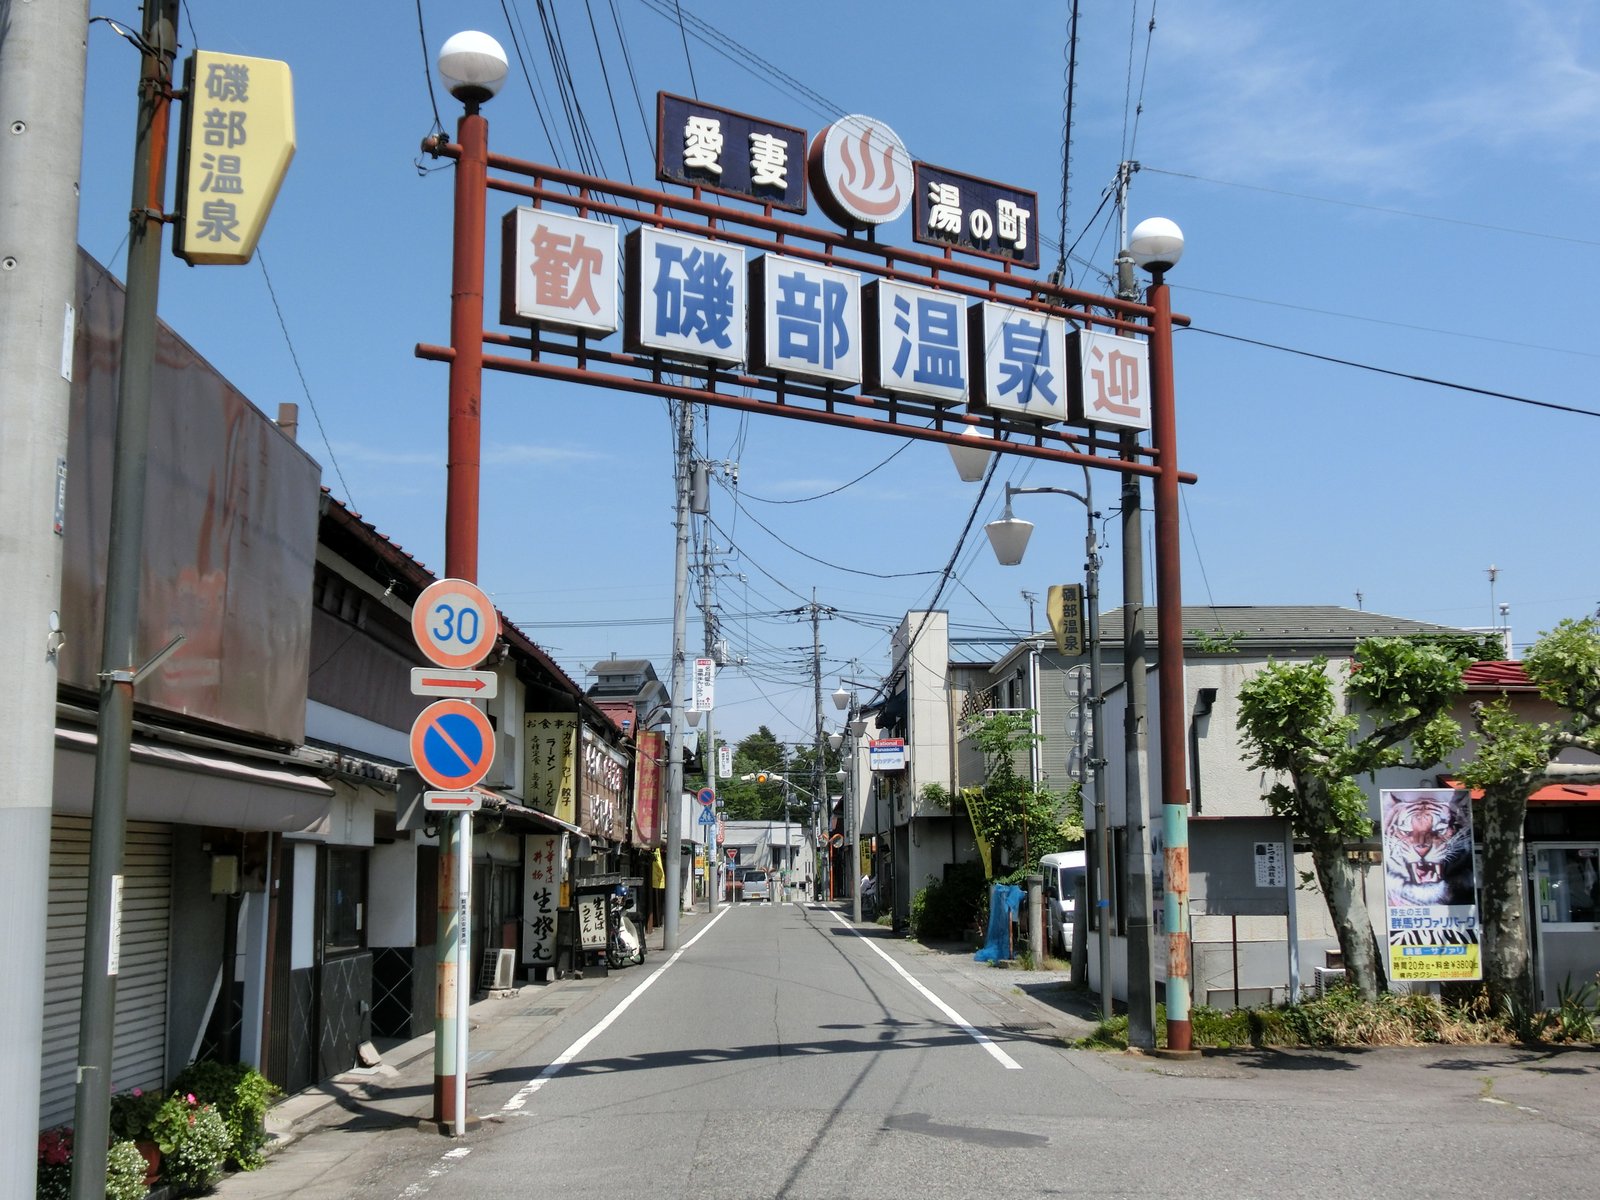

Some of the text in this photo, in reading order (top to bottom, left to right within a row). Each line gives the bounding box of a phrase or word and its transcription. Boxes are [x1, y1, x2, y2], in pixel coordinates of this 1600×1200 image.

[195, 62, 250, 242] 磯部温泉
[684, 115, 789, 190] 愛妻
[928, 182, 1030, 250] 湯の町
[530, 223, 1141, 419] 歓 磯部温泉 迎
[433, 603, 479, 645] 30
[1062, 587, 1079, 651] 磯部温泉
[527, 718, 579, 730] お食事処
[545, 738, 556, 806] ラーメン うどん
[545, 839, 555, 884] 中華そば
[582, 905, 592, 934] うどん
[593, 896, 605, 930] 生そば
[1391, 907, 1430, 917] 野生の王国
